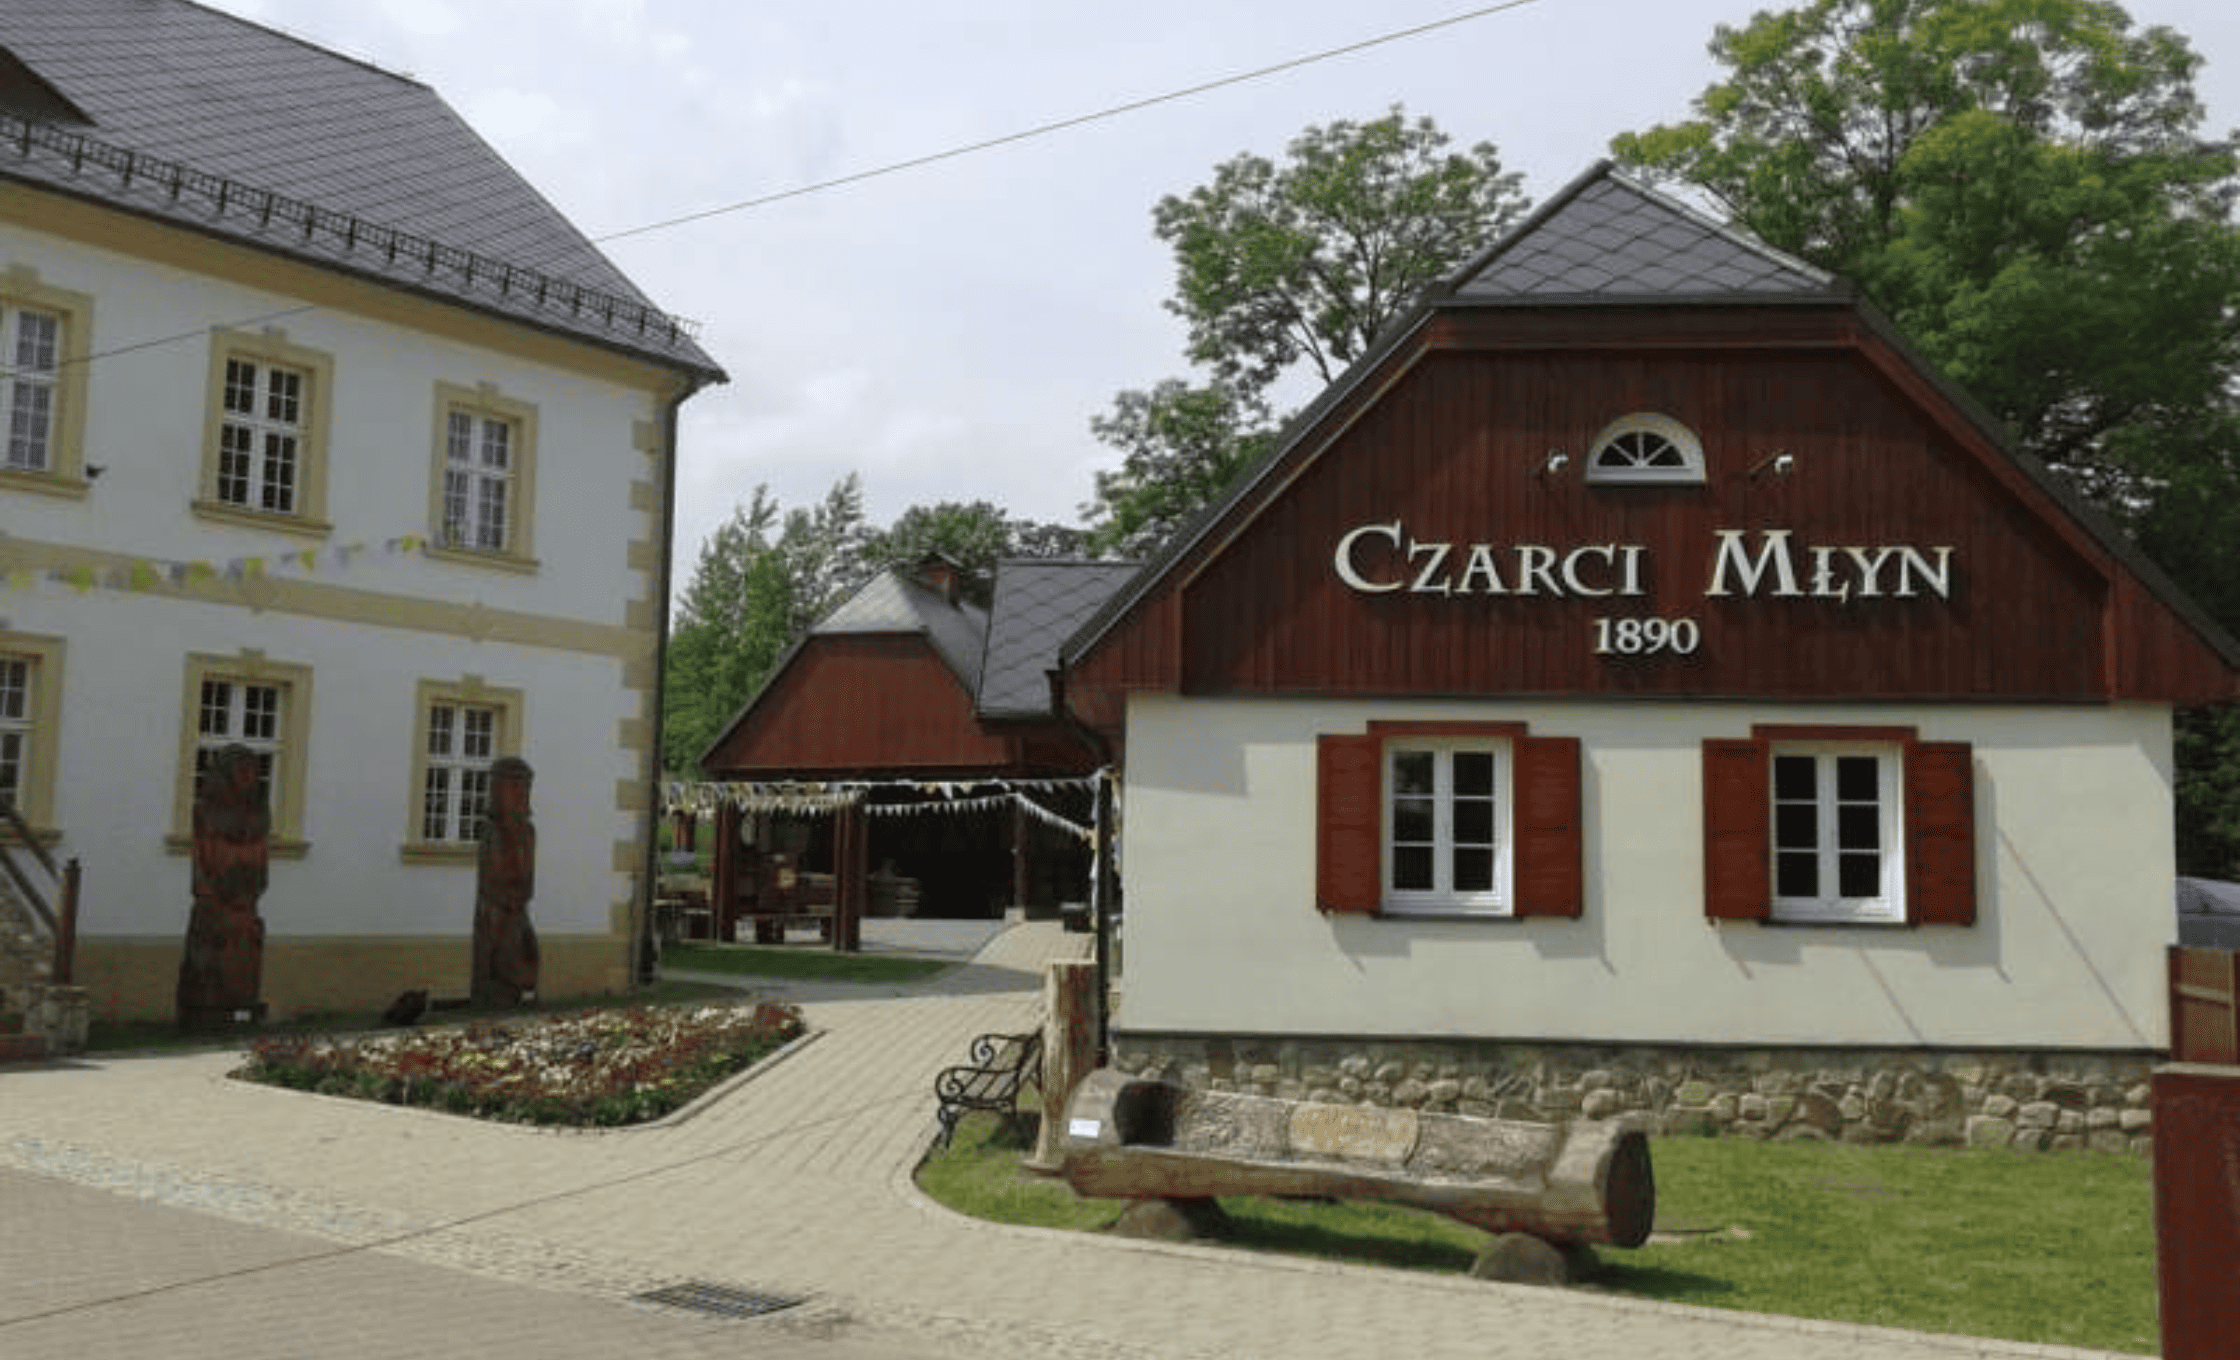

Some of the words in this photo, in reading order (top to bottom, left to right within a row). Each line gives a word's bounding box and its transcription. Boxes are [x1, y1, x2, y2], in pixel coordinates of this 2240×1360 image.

[1334, 521, 1647, 598] CZARCI
[1704, 530, 1953, 602] MŁYN
[1594, 617, 1698, 654] 1890
